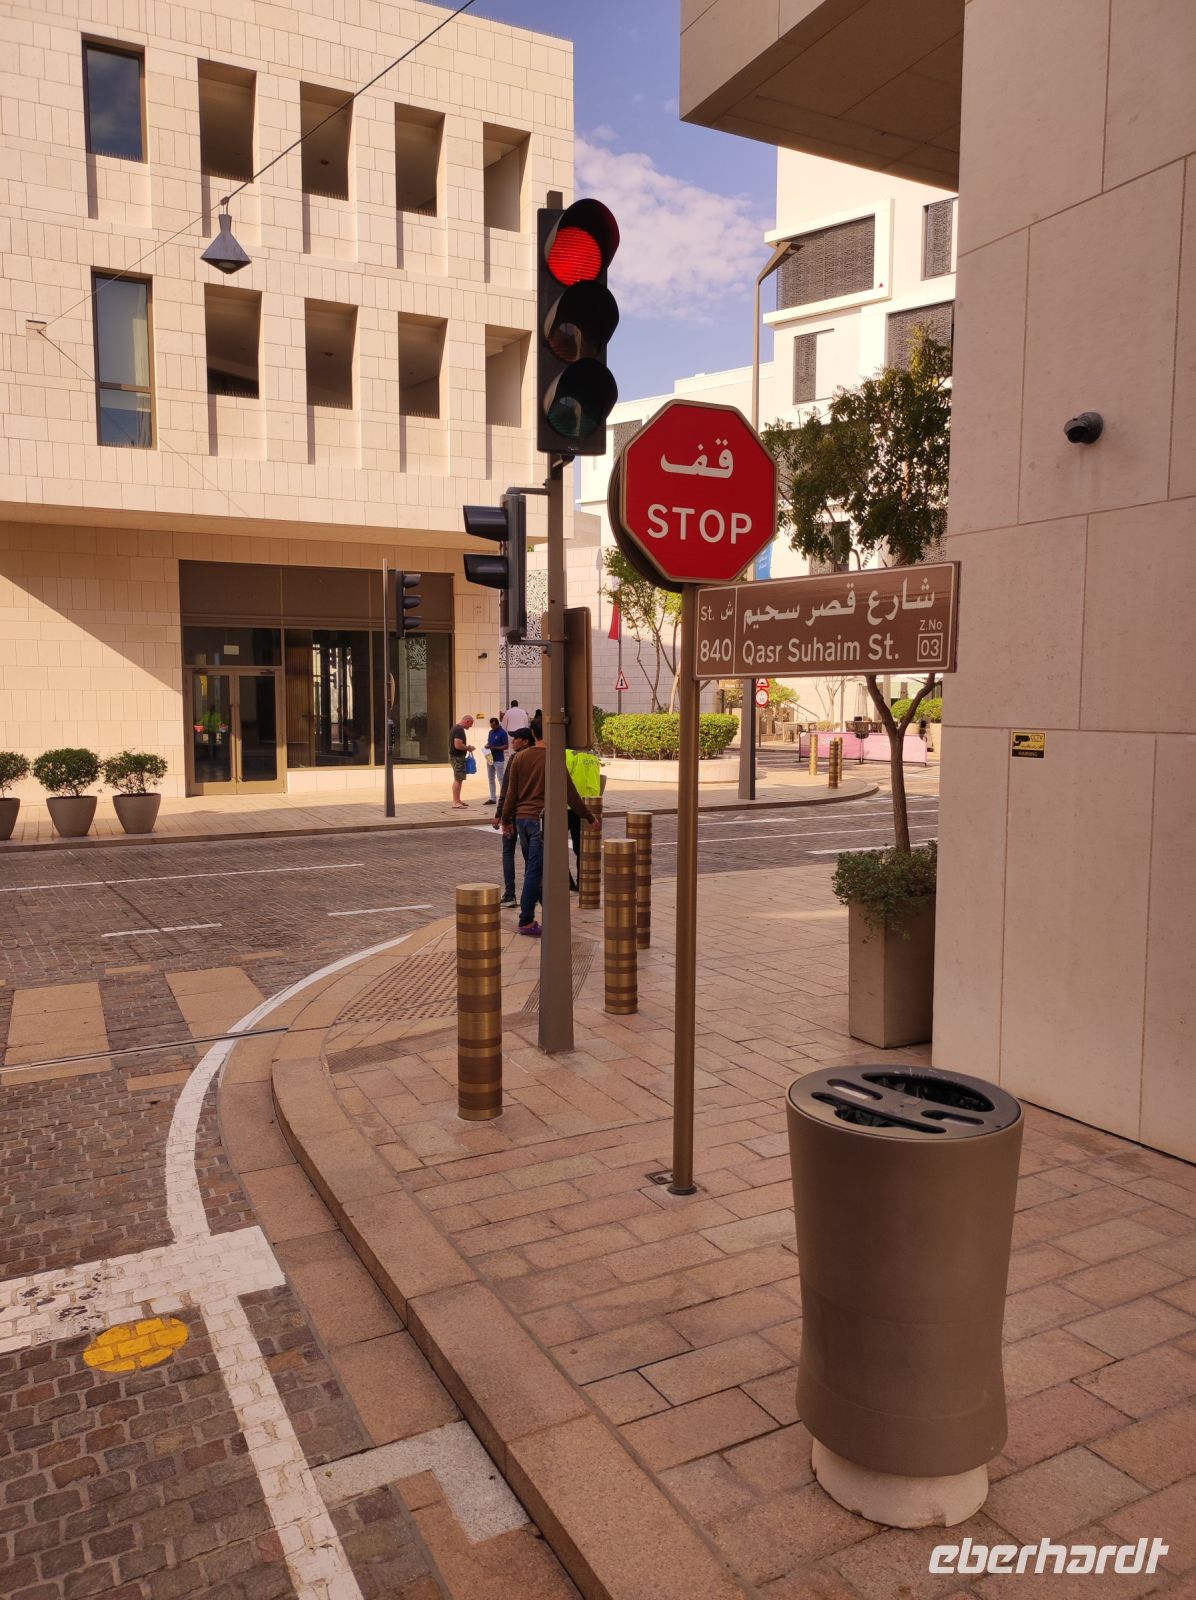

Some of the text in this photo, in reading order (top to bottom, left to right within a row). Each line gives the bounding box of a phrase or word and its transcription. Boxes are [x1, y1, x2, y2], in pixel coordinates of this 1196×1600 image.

[660, 438, 734, 479] قف
[647, 503, 753, 545] STOP
[700, 605, 715, 621] St.
[720, 600, 734, 621] ش
[743, 577, 935, 634] شارع قصر سحيم
[919, 618, 943, 631] Z.No
[700, 638, 732, 662] 840
[742, 632, 899, 666] Qasr Suhaim St.
[920, 638, 940, 657] 03
